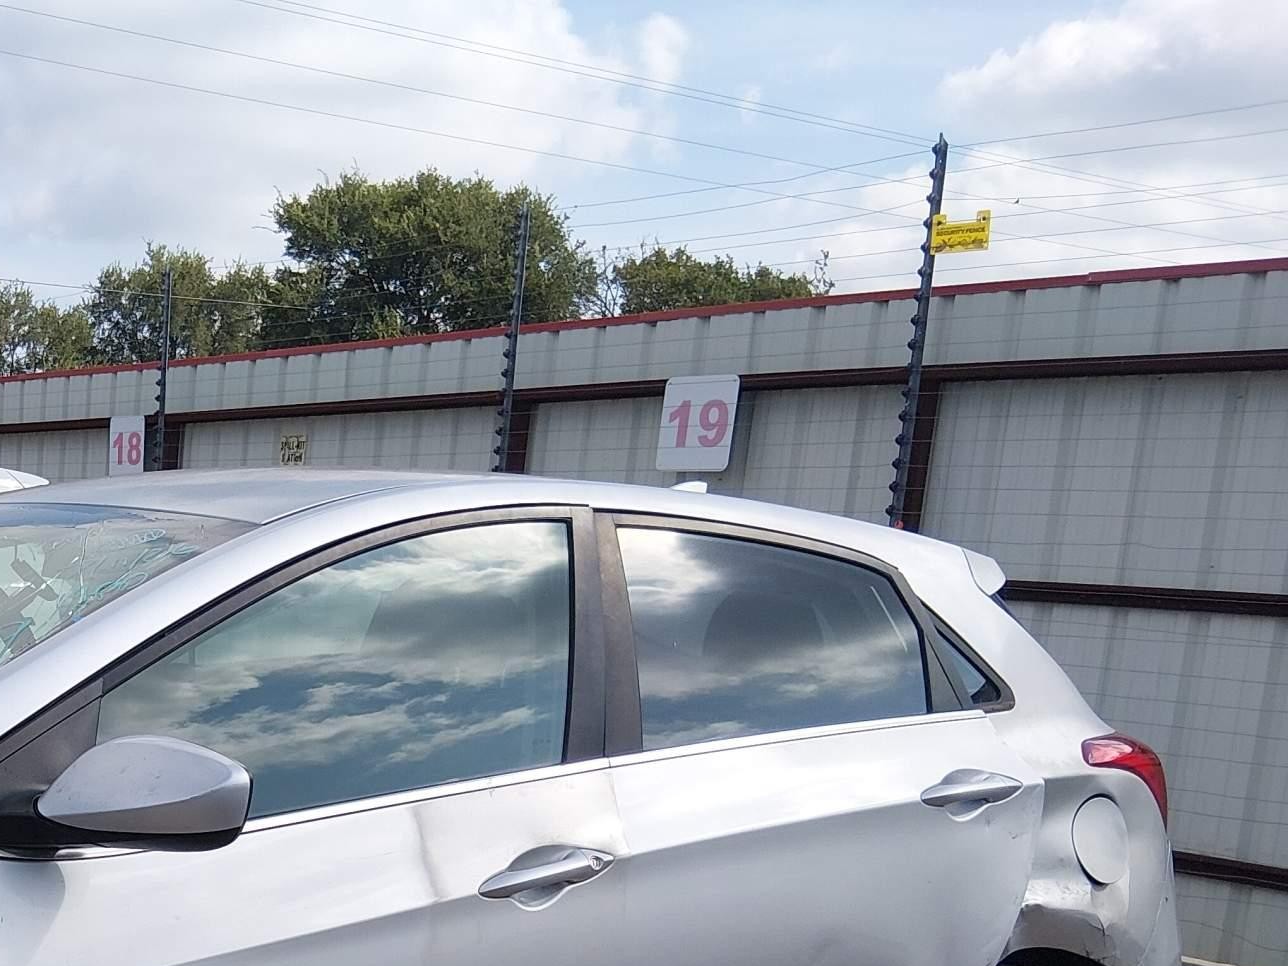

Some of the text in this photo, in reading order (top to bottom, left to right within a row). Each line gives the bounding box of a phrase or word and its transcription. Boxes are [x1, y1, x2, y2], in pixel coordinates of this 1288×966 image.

[669, 399, 729, 448] 19
[113, 431, 142, 466] 18
[281, 452, 303, 463] SATION
